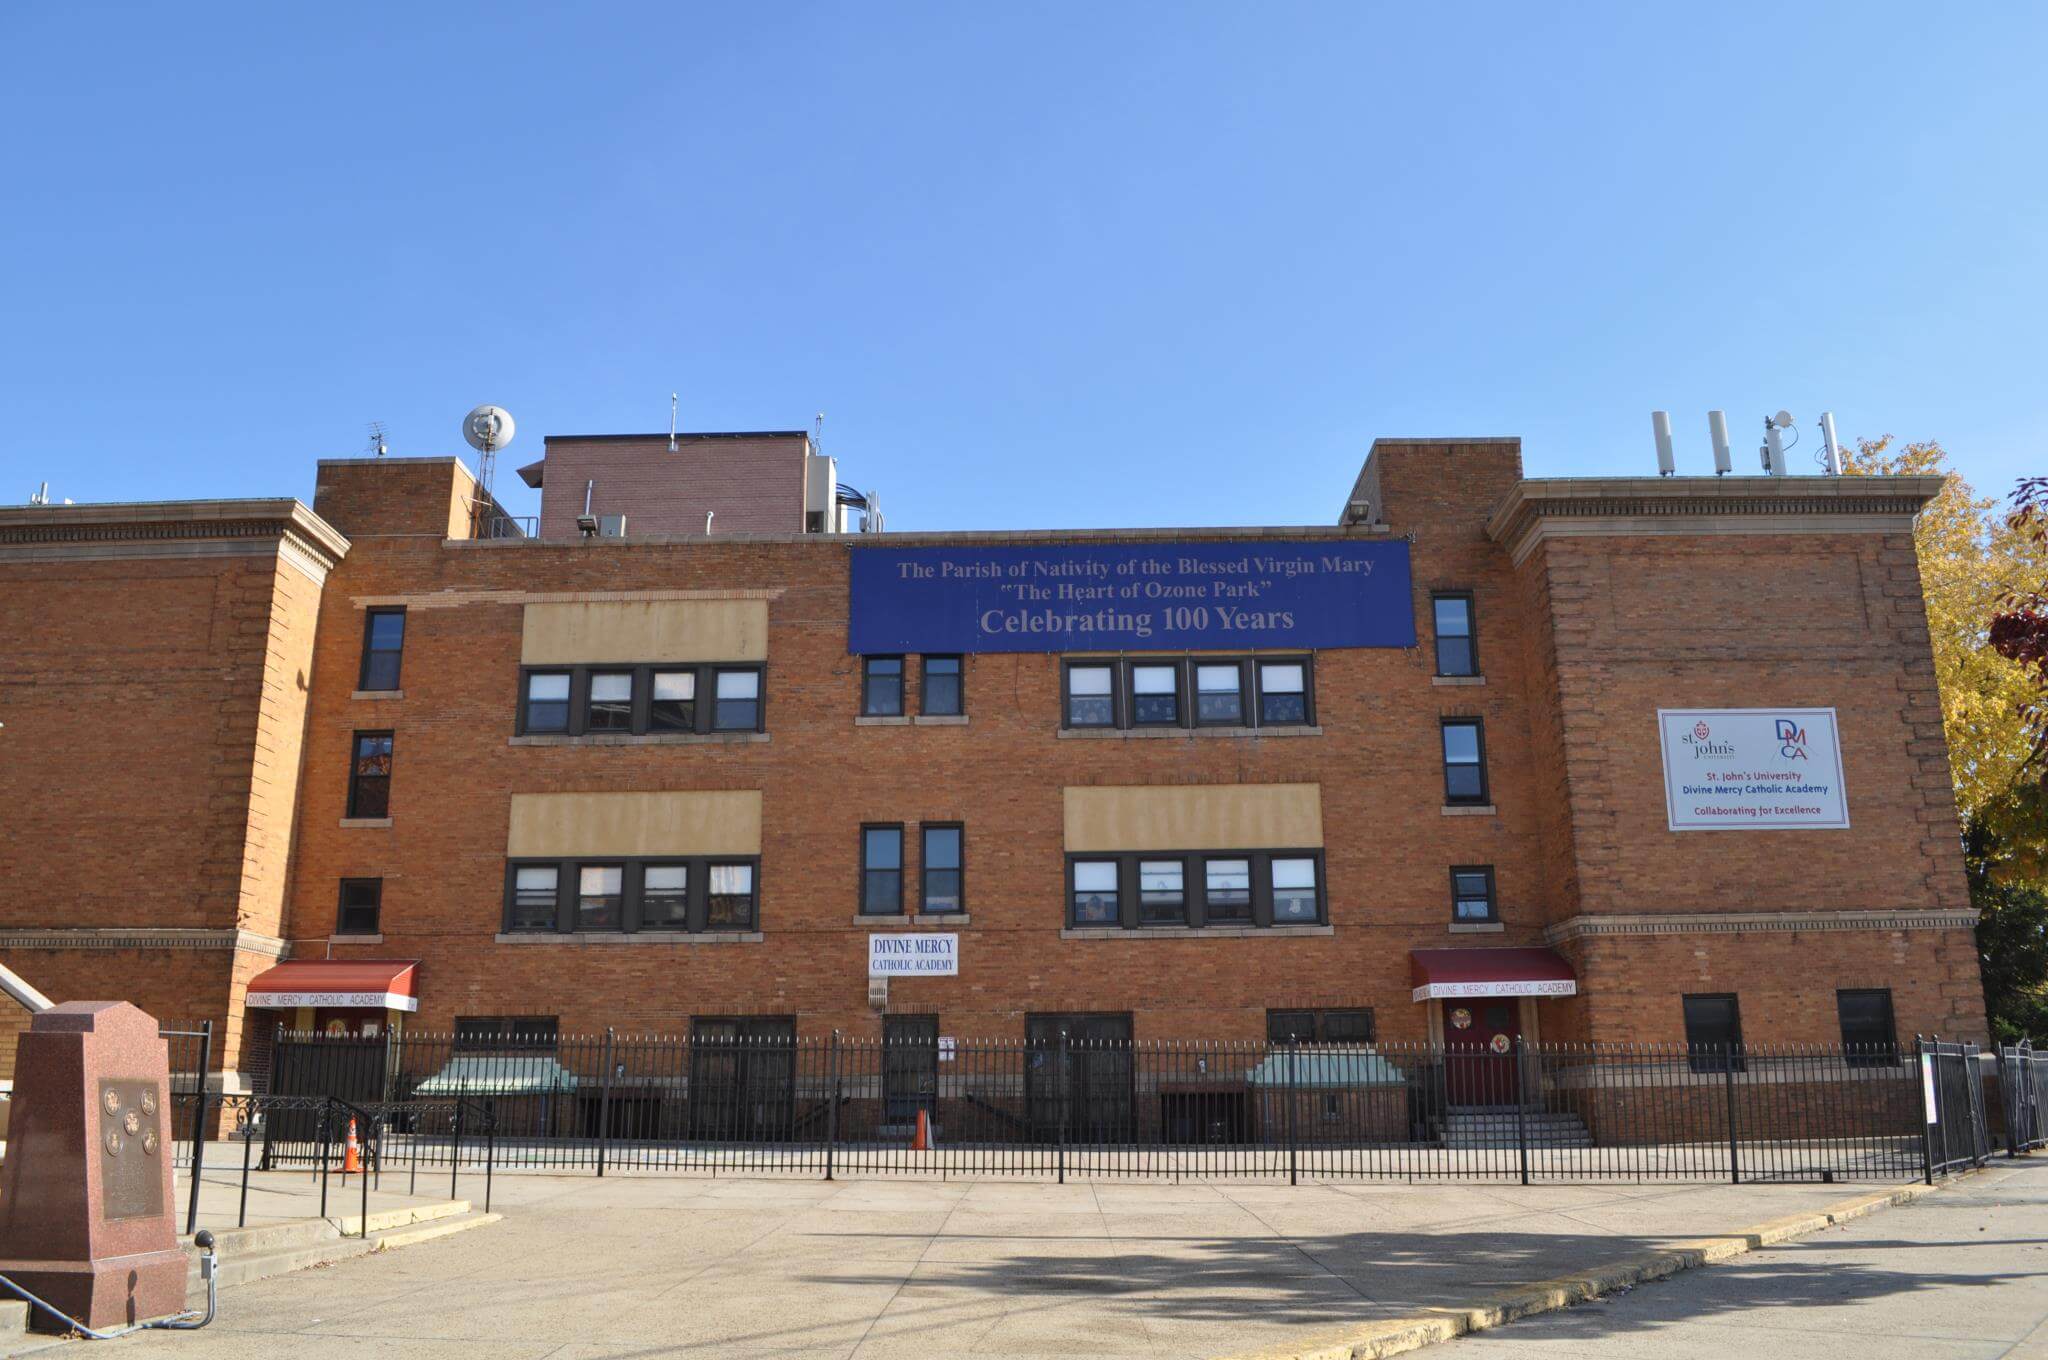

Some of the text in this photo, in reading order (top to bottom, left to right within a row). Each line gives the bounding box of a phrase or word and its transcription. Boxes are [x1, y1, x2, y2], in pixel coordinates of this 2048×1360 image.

[897, 556, 1375, 580] The Parish of Nativity of the Blessed Virgin Mary
[1058, 584, 1115, 600] Heart
[1120, 582, 1140, 598] of
[1144, 581, 1207, 598] Ozone
[980, 606, 1295, 637] Celebrating 100 Years
[1706, 771, 1802, 782] St. John's University
[1682, 784, 1828, 795] Divine Mercy Catholic Academy
[1694, 805, 1822, 817] Collaborating for Excellence
[874, 939, 953, 954] DIVINE MERCY
[872, 959, 954, 971] CATHOLIC ACADEMY
[1433, 985, 1457, 996] DIVINE
[1462, 984, 1490, 994] MERCY
[1495, 983, 1532, 994] CATHOLIC
[1537, 982, 1574, 994] ACADEMY
[249, 994, 386, 1006] DIVINE MERCY CATHOLIC ACADEMY
